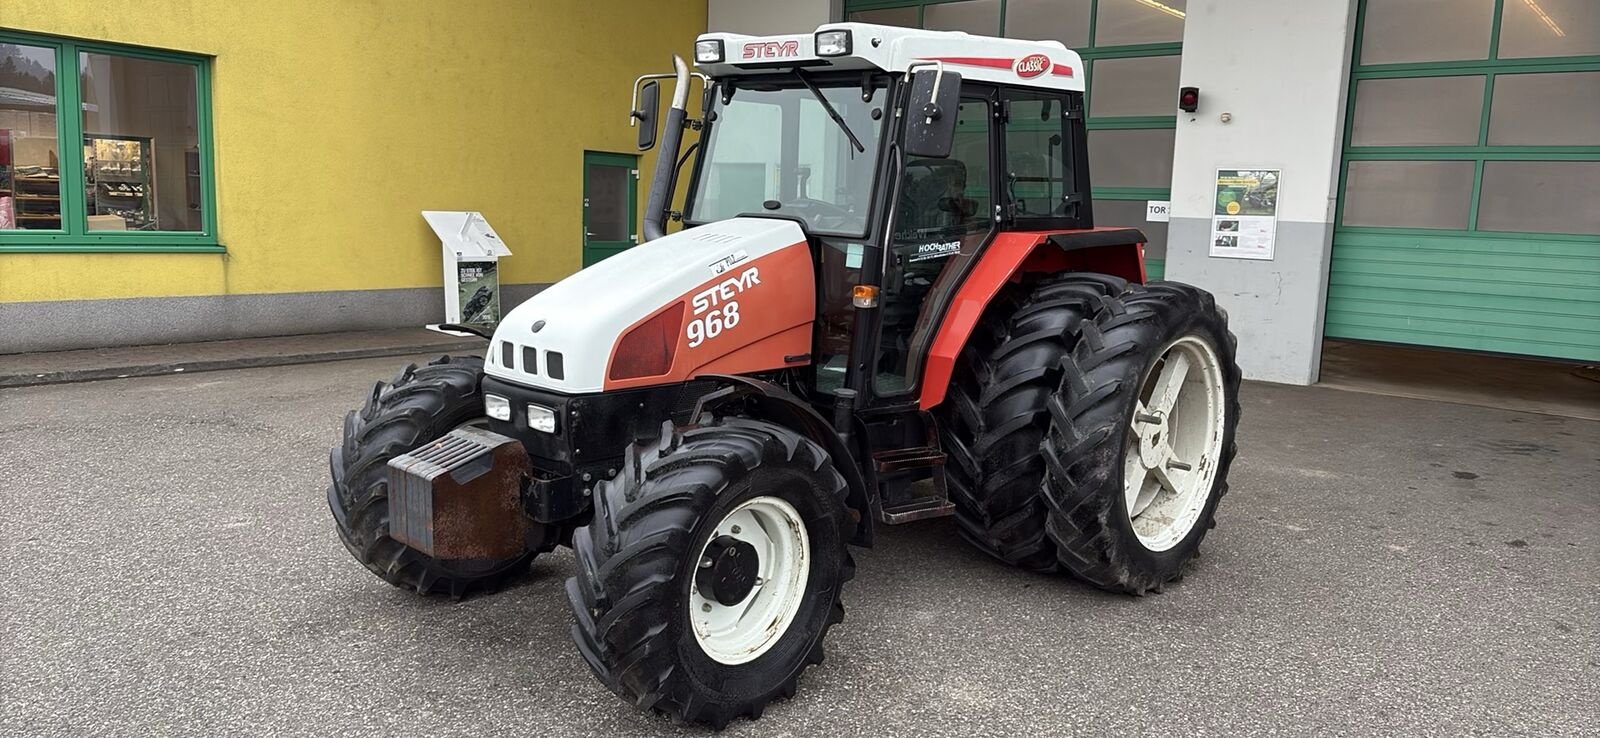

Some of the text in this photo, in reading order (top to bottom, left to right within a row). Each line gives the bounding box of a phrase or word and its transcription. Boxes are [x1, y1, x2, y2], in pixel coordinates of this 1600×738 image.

[743, 41, 798, 58] STEYR
[1018, 60, 1043, 72] CLASSIC
[1149, 205, 1166, 214] TOR
[692, 266, 761, 316] STEYR
[686, 301, 740, 348] 968
